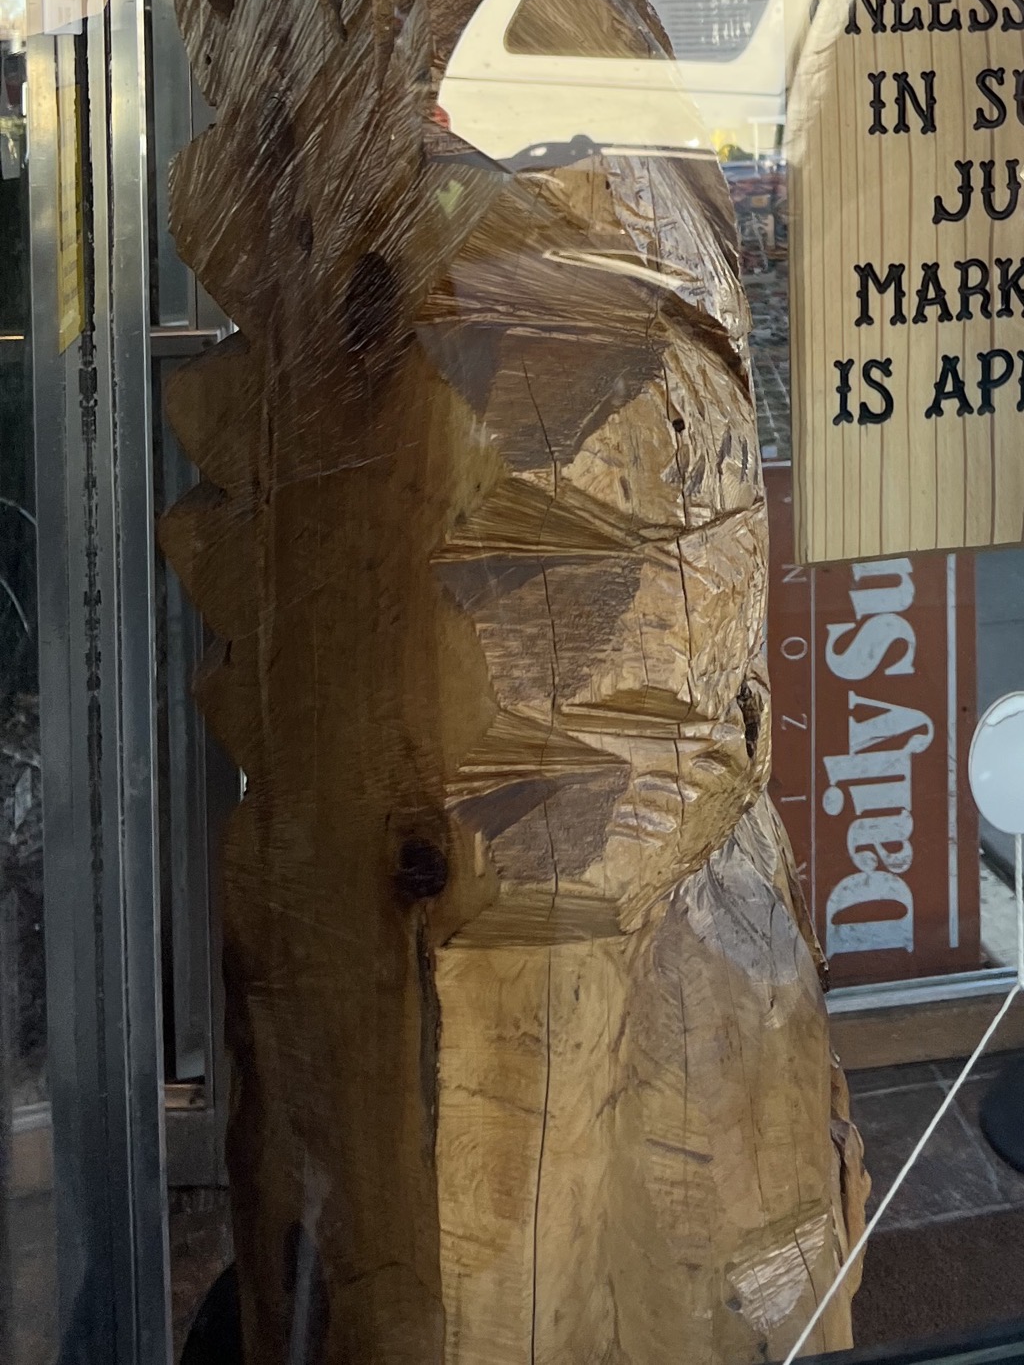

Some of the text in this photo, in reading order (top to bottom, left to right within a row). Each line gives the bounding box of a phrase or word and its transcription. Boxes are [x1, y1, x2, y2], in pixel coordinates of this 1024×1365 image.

[867, 70, 937, 135] IN
[833, 358, 895, 426] IS
[822, 691, 934, 960] Daily
